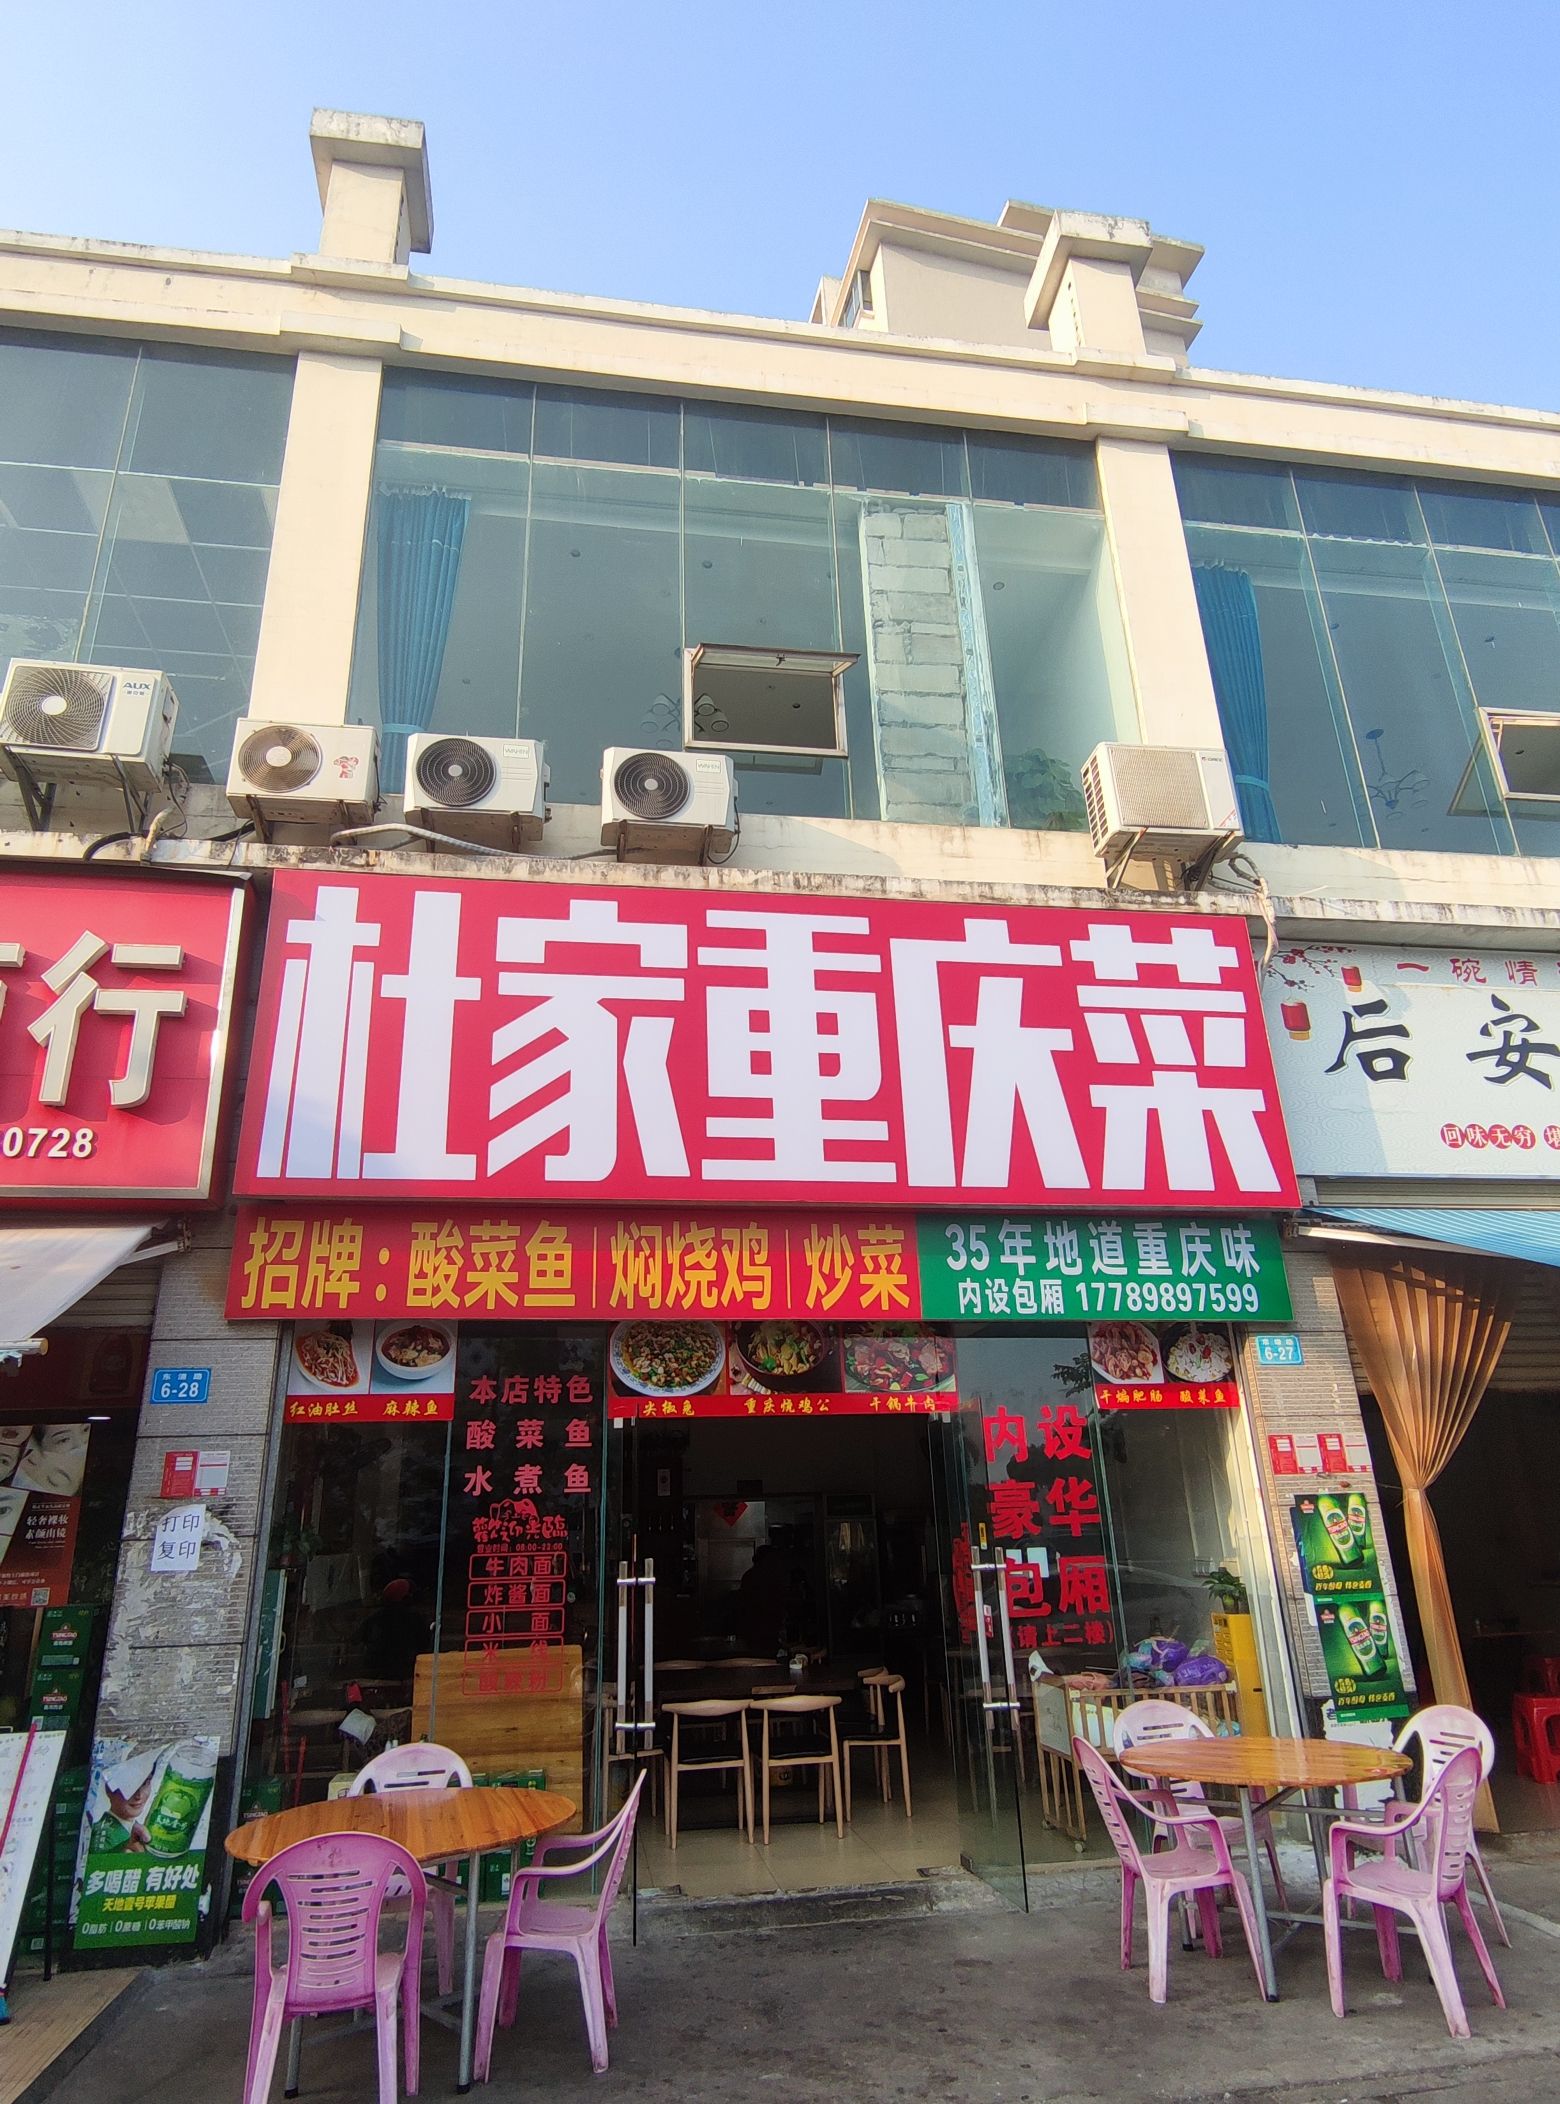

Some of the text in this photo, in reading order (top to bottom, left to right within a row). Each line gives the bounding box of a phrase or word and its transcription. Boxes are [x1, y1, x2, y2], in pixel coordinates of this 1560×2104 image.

[122, 682, 151, 690] AUX
[1396, 958, 1560, 986] 一碗情
[0, 929, 189, 1109] 行
[256, 885, 1282, 1193] 杜家重庆菜
[1324, 993, 1560, 1090] 后安
[2, 1126, 95, 1158] 0728
[1441, 1124, 1536, 1149] 回味无穷
[945, 1218, 1261, 1277] 35年地道重庆味
[609, 1221, 772, 1310] 焖烧鸡
[804, 1223, 911, 1311] 炒菜
[957, 1277, 1259, 1314] 内设包厢 17789897599
[1264, 1346, 1293, 1361] 6-27
[160, 1382, 200, 1398] 6-28
[469, 1374, 593, 1404] 本店特色
[1179, 1387, 1227, 1405] 酸菜鱼
[382, 1400, 439, 1416] 麻辣鱼
[743, 1397, 831, 1415] 重庆烧鸡公
[466, 1418, 593, 1450] 酸菜鱼
[983, 1404, 1093, 1463] 内设
[463, 1463, 592, 1496] 水煮鱼
[162, 1513, 200, 1532] 打印
[987, 1476, 1101, 1540] 豪华
[157, 1540, 197, 1560] 复印
[485, 1555, 553, 1577] 牛肉面
[484, 1583, 551, 1605] 炸酱面
[1004, 1555, 1111, 1618] 包厢
[482, 1612, 549, 1634] 小面
[85, 1864, 200, 1895] 多喝醋 有好处
